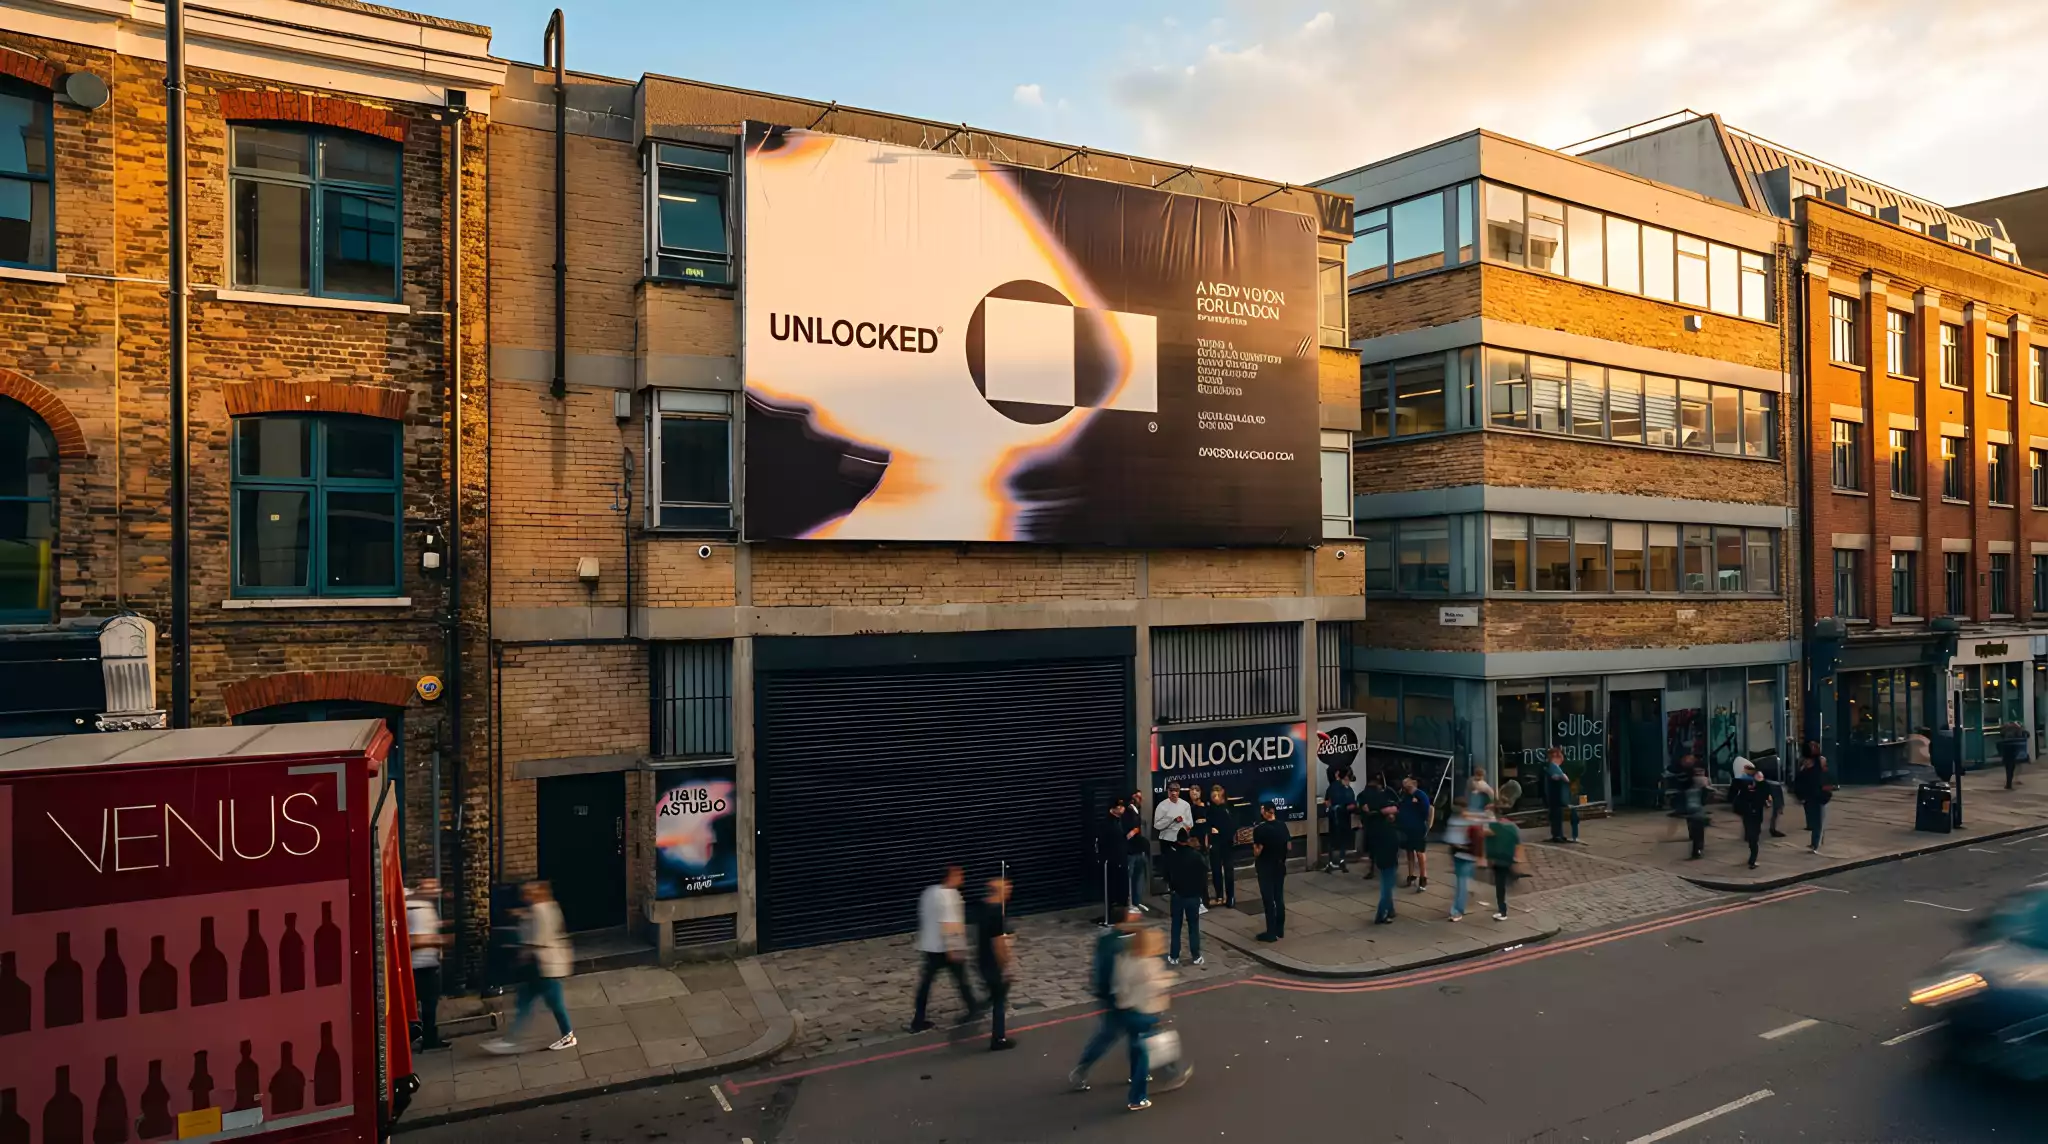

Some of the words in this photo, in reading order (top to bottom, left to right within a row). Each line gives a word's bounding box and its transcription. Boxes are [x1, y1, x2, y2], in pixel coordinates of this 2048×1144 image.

[1197, 297, 1224, 313] FOR
[1159, 735, 1295, 770] UNLOCKED
[46, 792, 321, 874] VENUS
